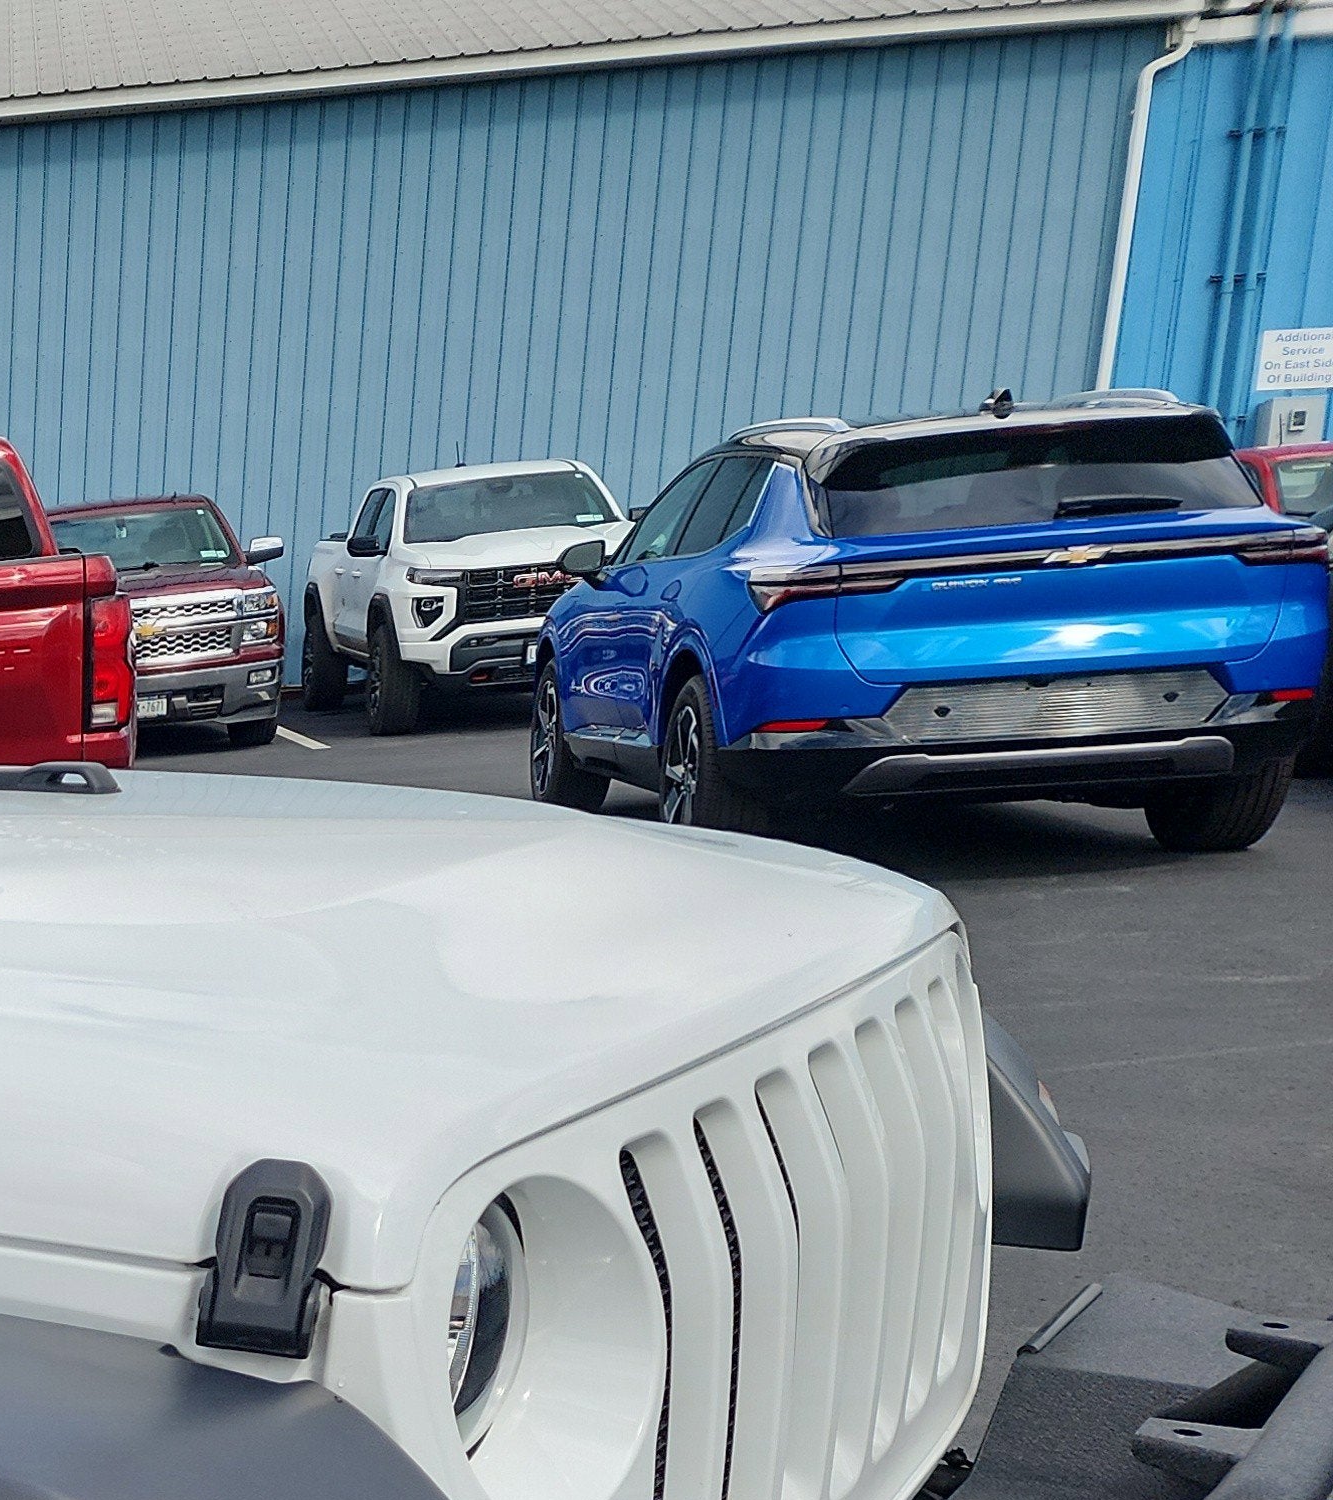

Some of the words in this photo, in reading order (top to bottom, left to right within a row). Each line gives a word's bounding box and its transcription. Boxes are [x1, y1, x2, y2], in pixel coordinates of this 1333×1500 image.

[1276, 332, 1333, 342] Additiona
[1282, 345, 1326, 356] Service
[1264, 360, 1281, 370] On
[1285, 359, 1310, 370] East
[1266, 373, 1282, 384] Of
[1284, 373, 1332, 384] Building
